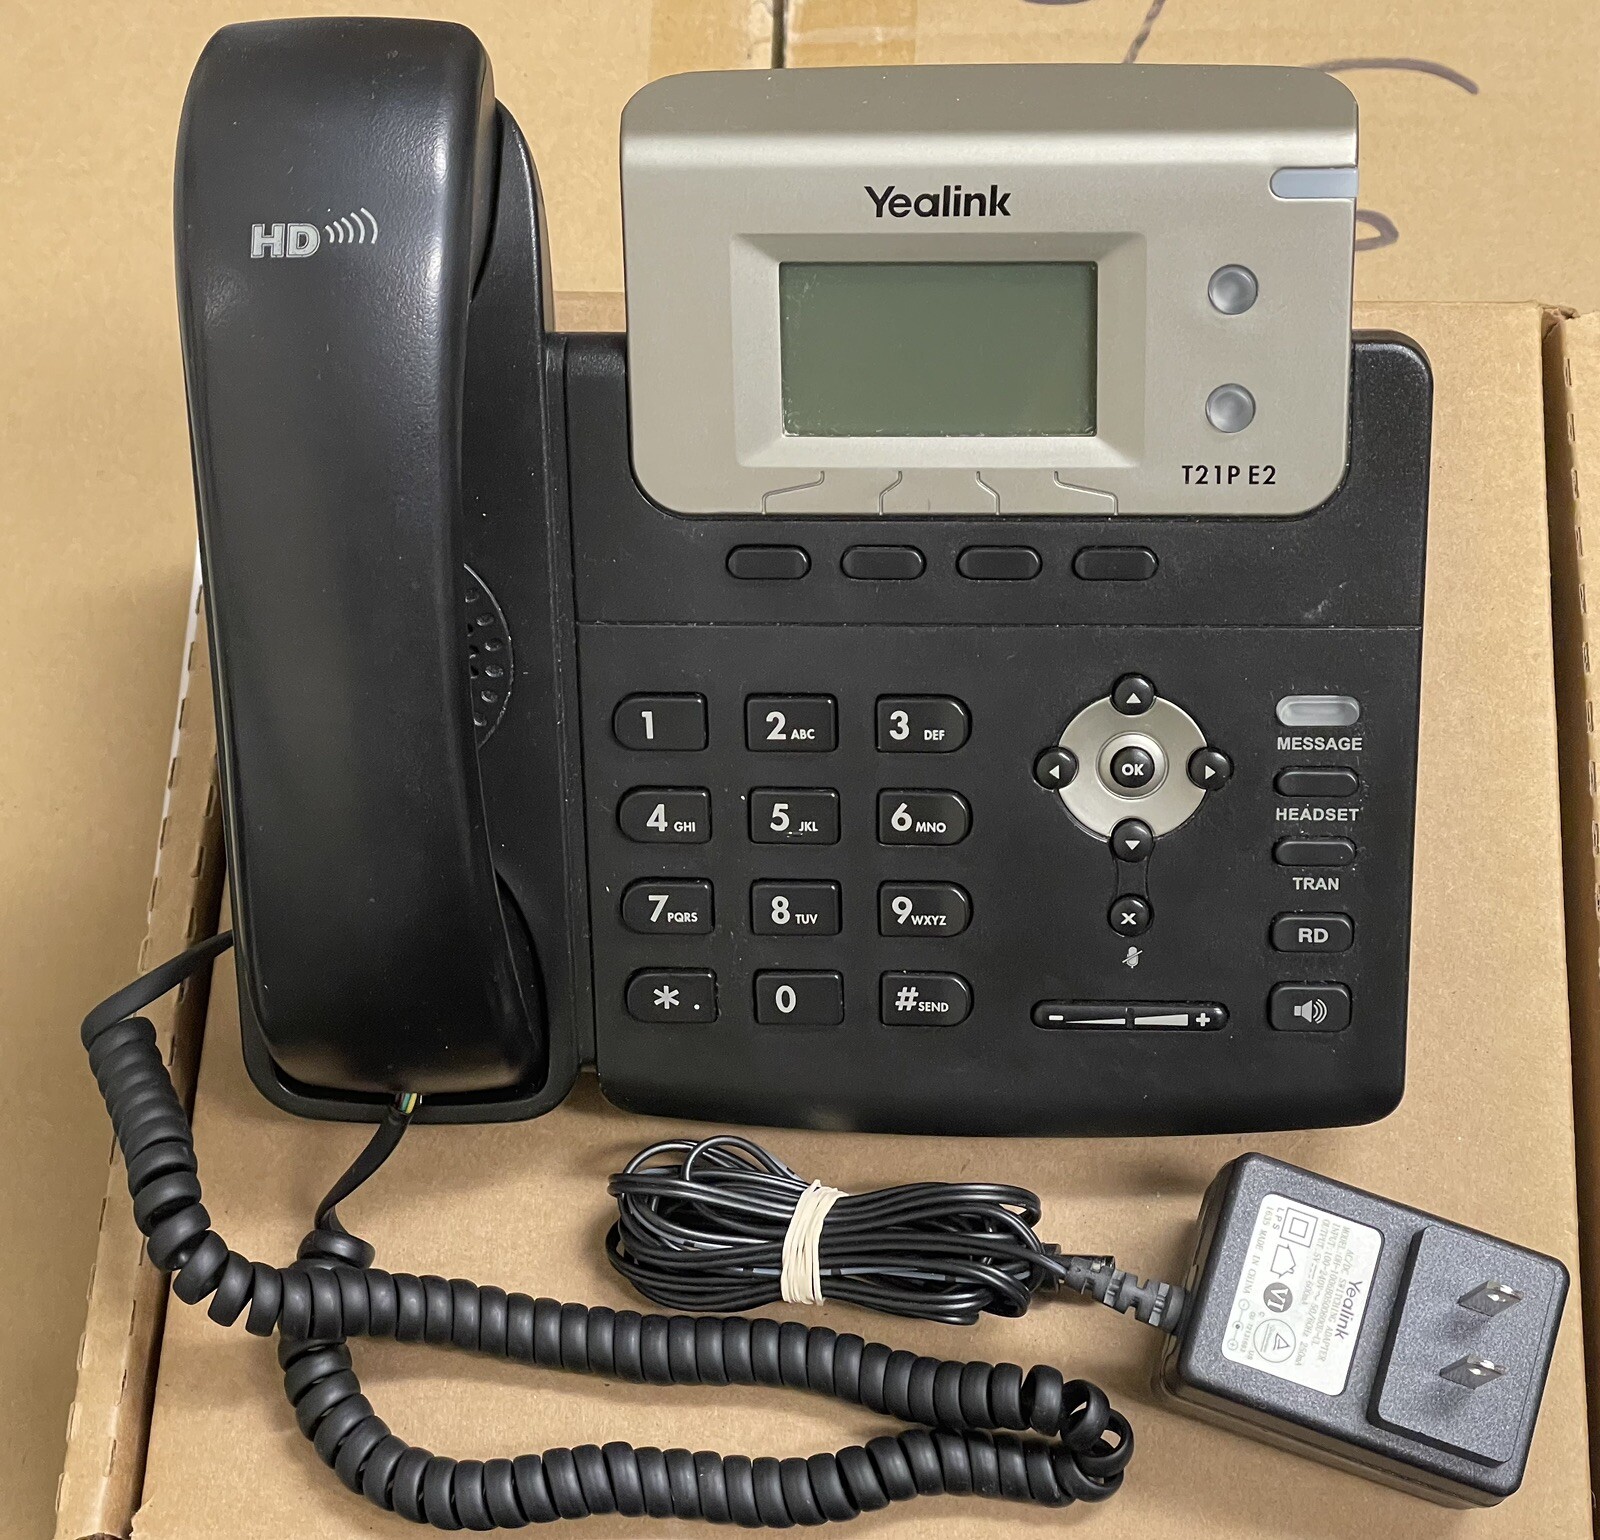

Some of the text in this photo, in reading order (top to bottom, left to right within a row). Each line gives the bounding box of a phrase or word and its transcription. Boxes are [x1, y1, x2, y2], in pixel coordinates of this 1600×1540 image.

[863, 184, 1012, 218] Yealink
[251, 223, 320, 258] HD
[1182, 464, 1276, 485] T21P E2
[642, 711, 653, 739] 1
[766, 712, 815, 740] 2 ABC
[890, 711, 945, 740] 3 DEF
[1277, 737, 1363, 751] MESSAGE
[1121, 763, 1144, 776] OK
[647, 804, 695, 832] 4 GHI
[770, 803, 818, 831] 5 JKL
[891, 803, 946, 833] 6 MNO
[1275, 807, 1359, 822] HEADSET
[1293, 877, 1339, 890] TRAN
[649, 895, 698, 922] 7 PQRS
[772, 896, 817, 924] 8 TUV
[892, 897, 946, 925] 9 WXYZ
[1299, 928, 1328, 943] RD
[776, 986, 796, 1013] 0
[918, 1002, 948, 1012] SEND
[1242, 1206, 1274, 1293] 1635 MADE IN CHINA
[1316, 1248, 1354, 1362] AC/DC SWITCHING ADAPTER
[1333, 1280, 1363, 1340] Yealink
[1302, 1302, 1318, 1337] 50/60Hz
[1294, 1340, 1308, 1366] 250mA
